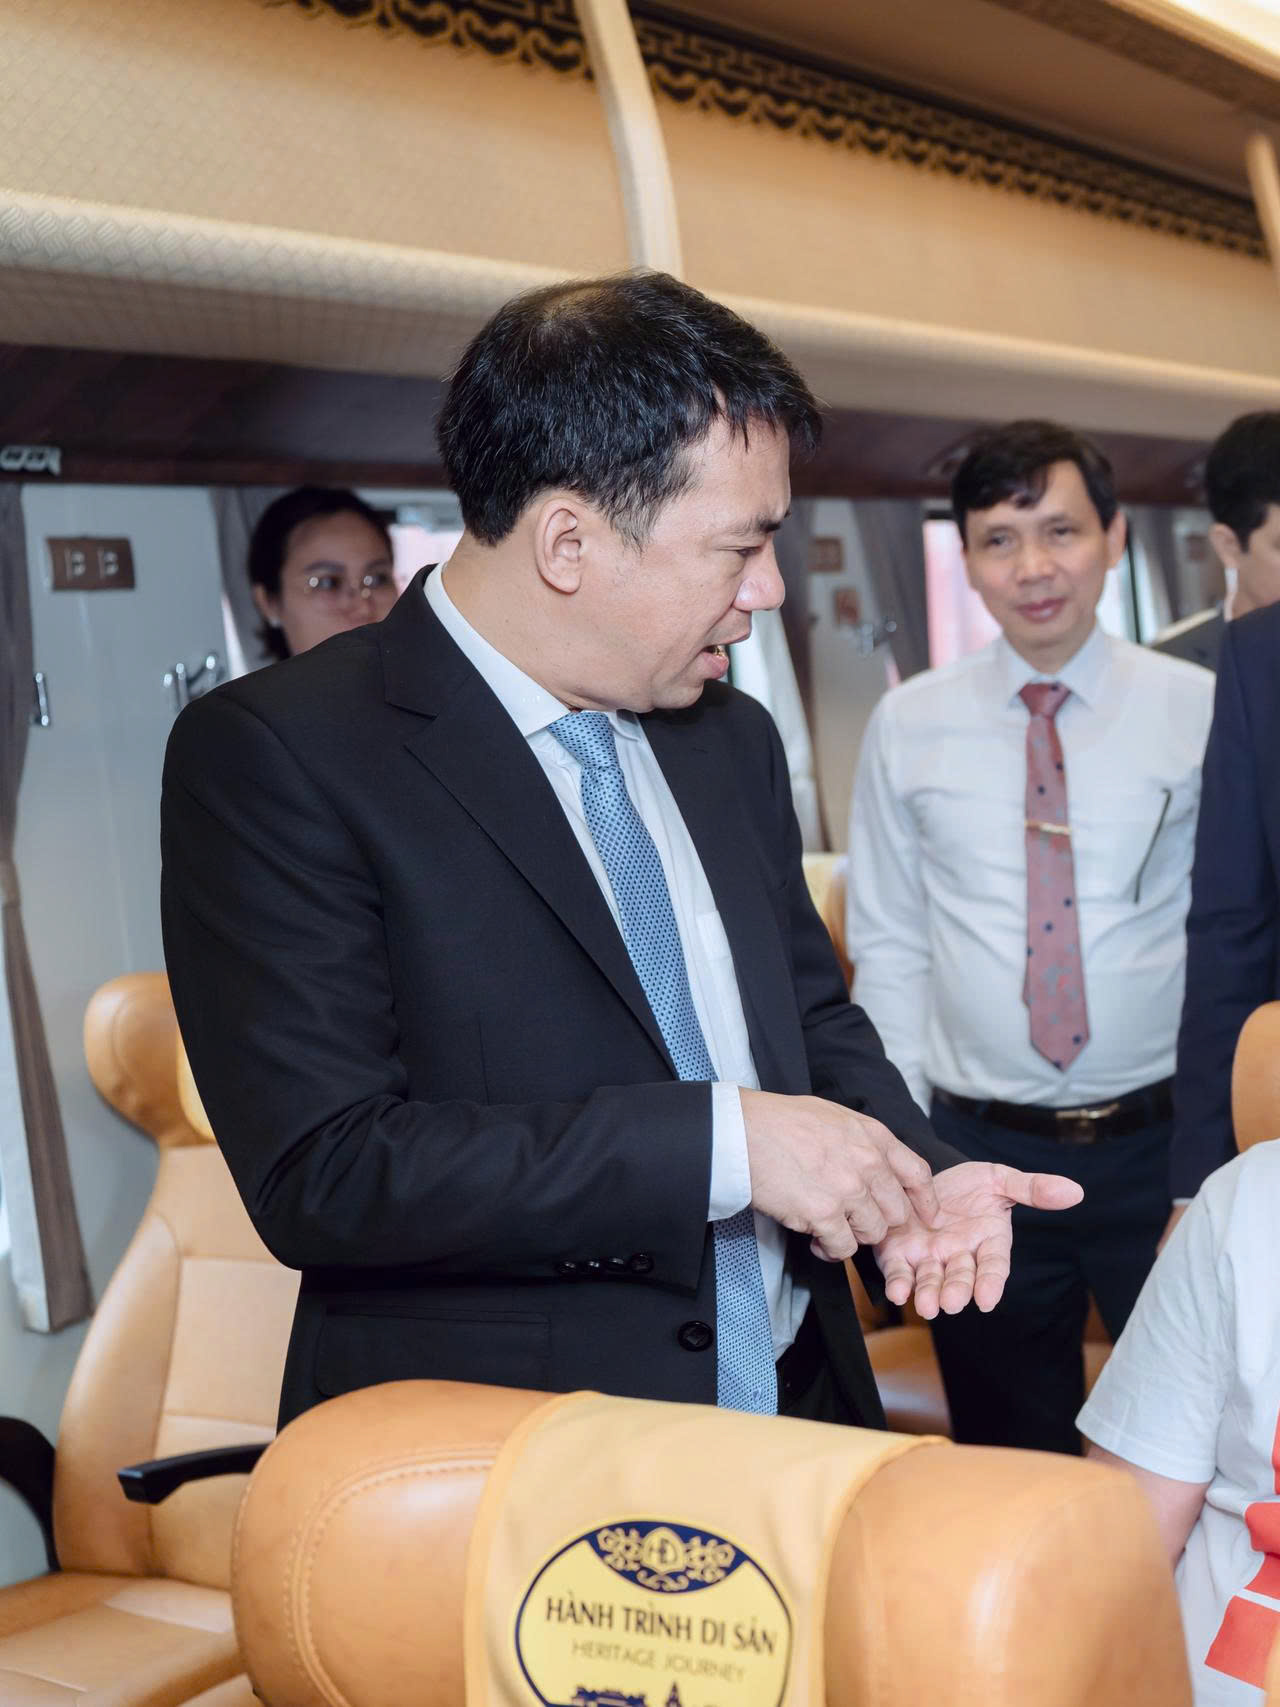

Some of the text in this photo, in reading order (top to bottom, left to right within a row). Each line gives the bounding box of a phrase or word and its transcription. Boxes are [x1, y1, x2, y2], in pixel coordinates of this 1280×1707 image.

[545, 1590, 777, 1655] HÀNH TRÌNH DI SẢN
[571, 1639, 747, 1682] HERITAGE JOURNEY
